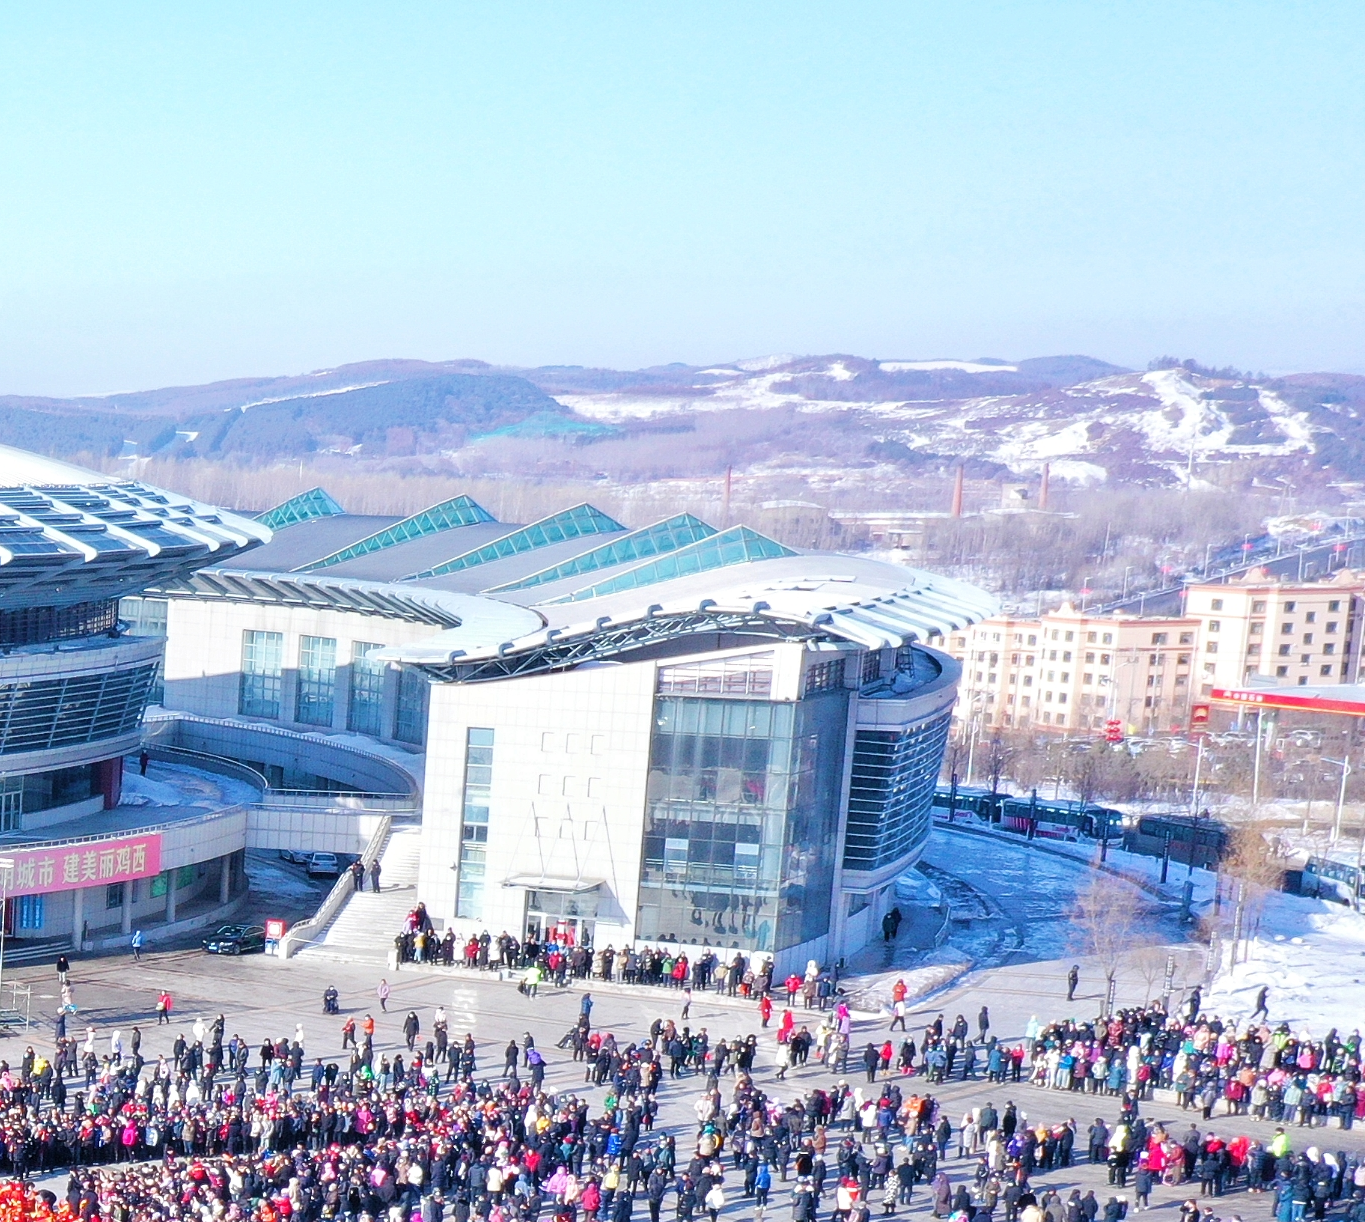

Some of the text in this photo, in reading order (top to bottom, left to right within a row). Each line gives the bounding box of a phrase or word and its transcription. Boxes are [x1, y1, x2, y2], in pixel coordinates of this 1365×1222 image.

[61, 841, 147, 884] 建美丽鸡西
